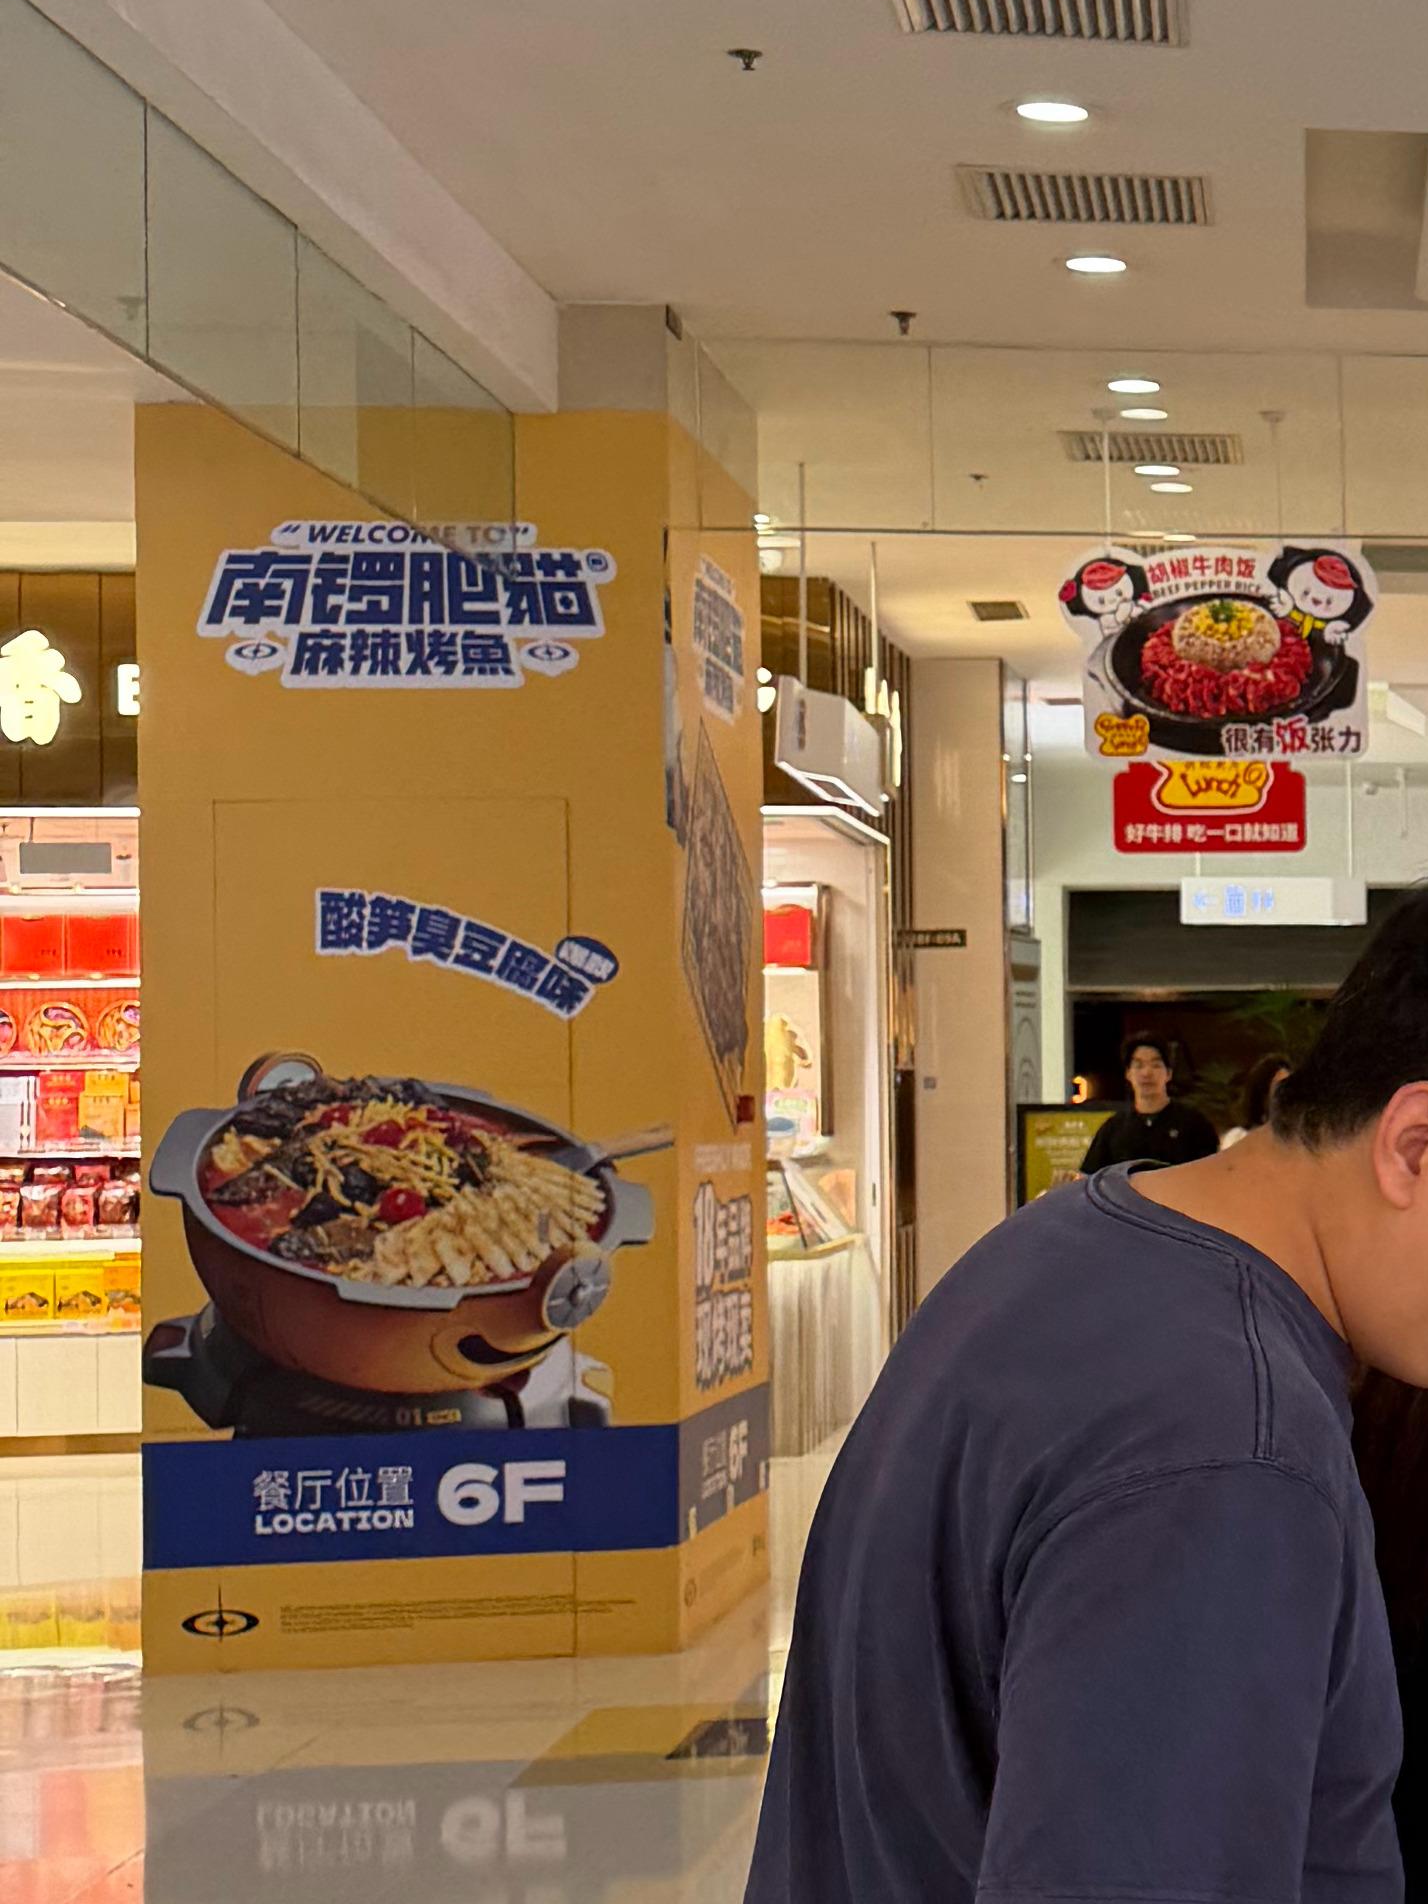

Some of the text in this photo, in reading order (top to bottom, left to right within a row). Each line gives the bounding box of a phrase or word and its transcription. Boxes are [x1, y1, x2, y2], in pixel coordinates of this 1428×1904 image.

[1148, 555, 1257, 585] 胡椒牛肉饭
[1184, 579, 1232, 591] PEPPER
[1235, 581, 1261, 593] RICE
[1225, 719, 1361, 754] 很有饭张力
[253, 1466, 414, 1512] 餐厅位置
[437, 1460, 566, 1526] 6F
[254, 1509, 415, 1536] LOCATION
